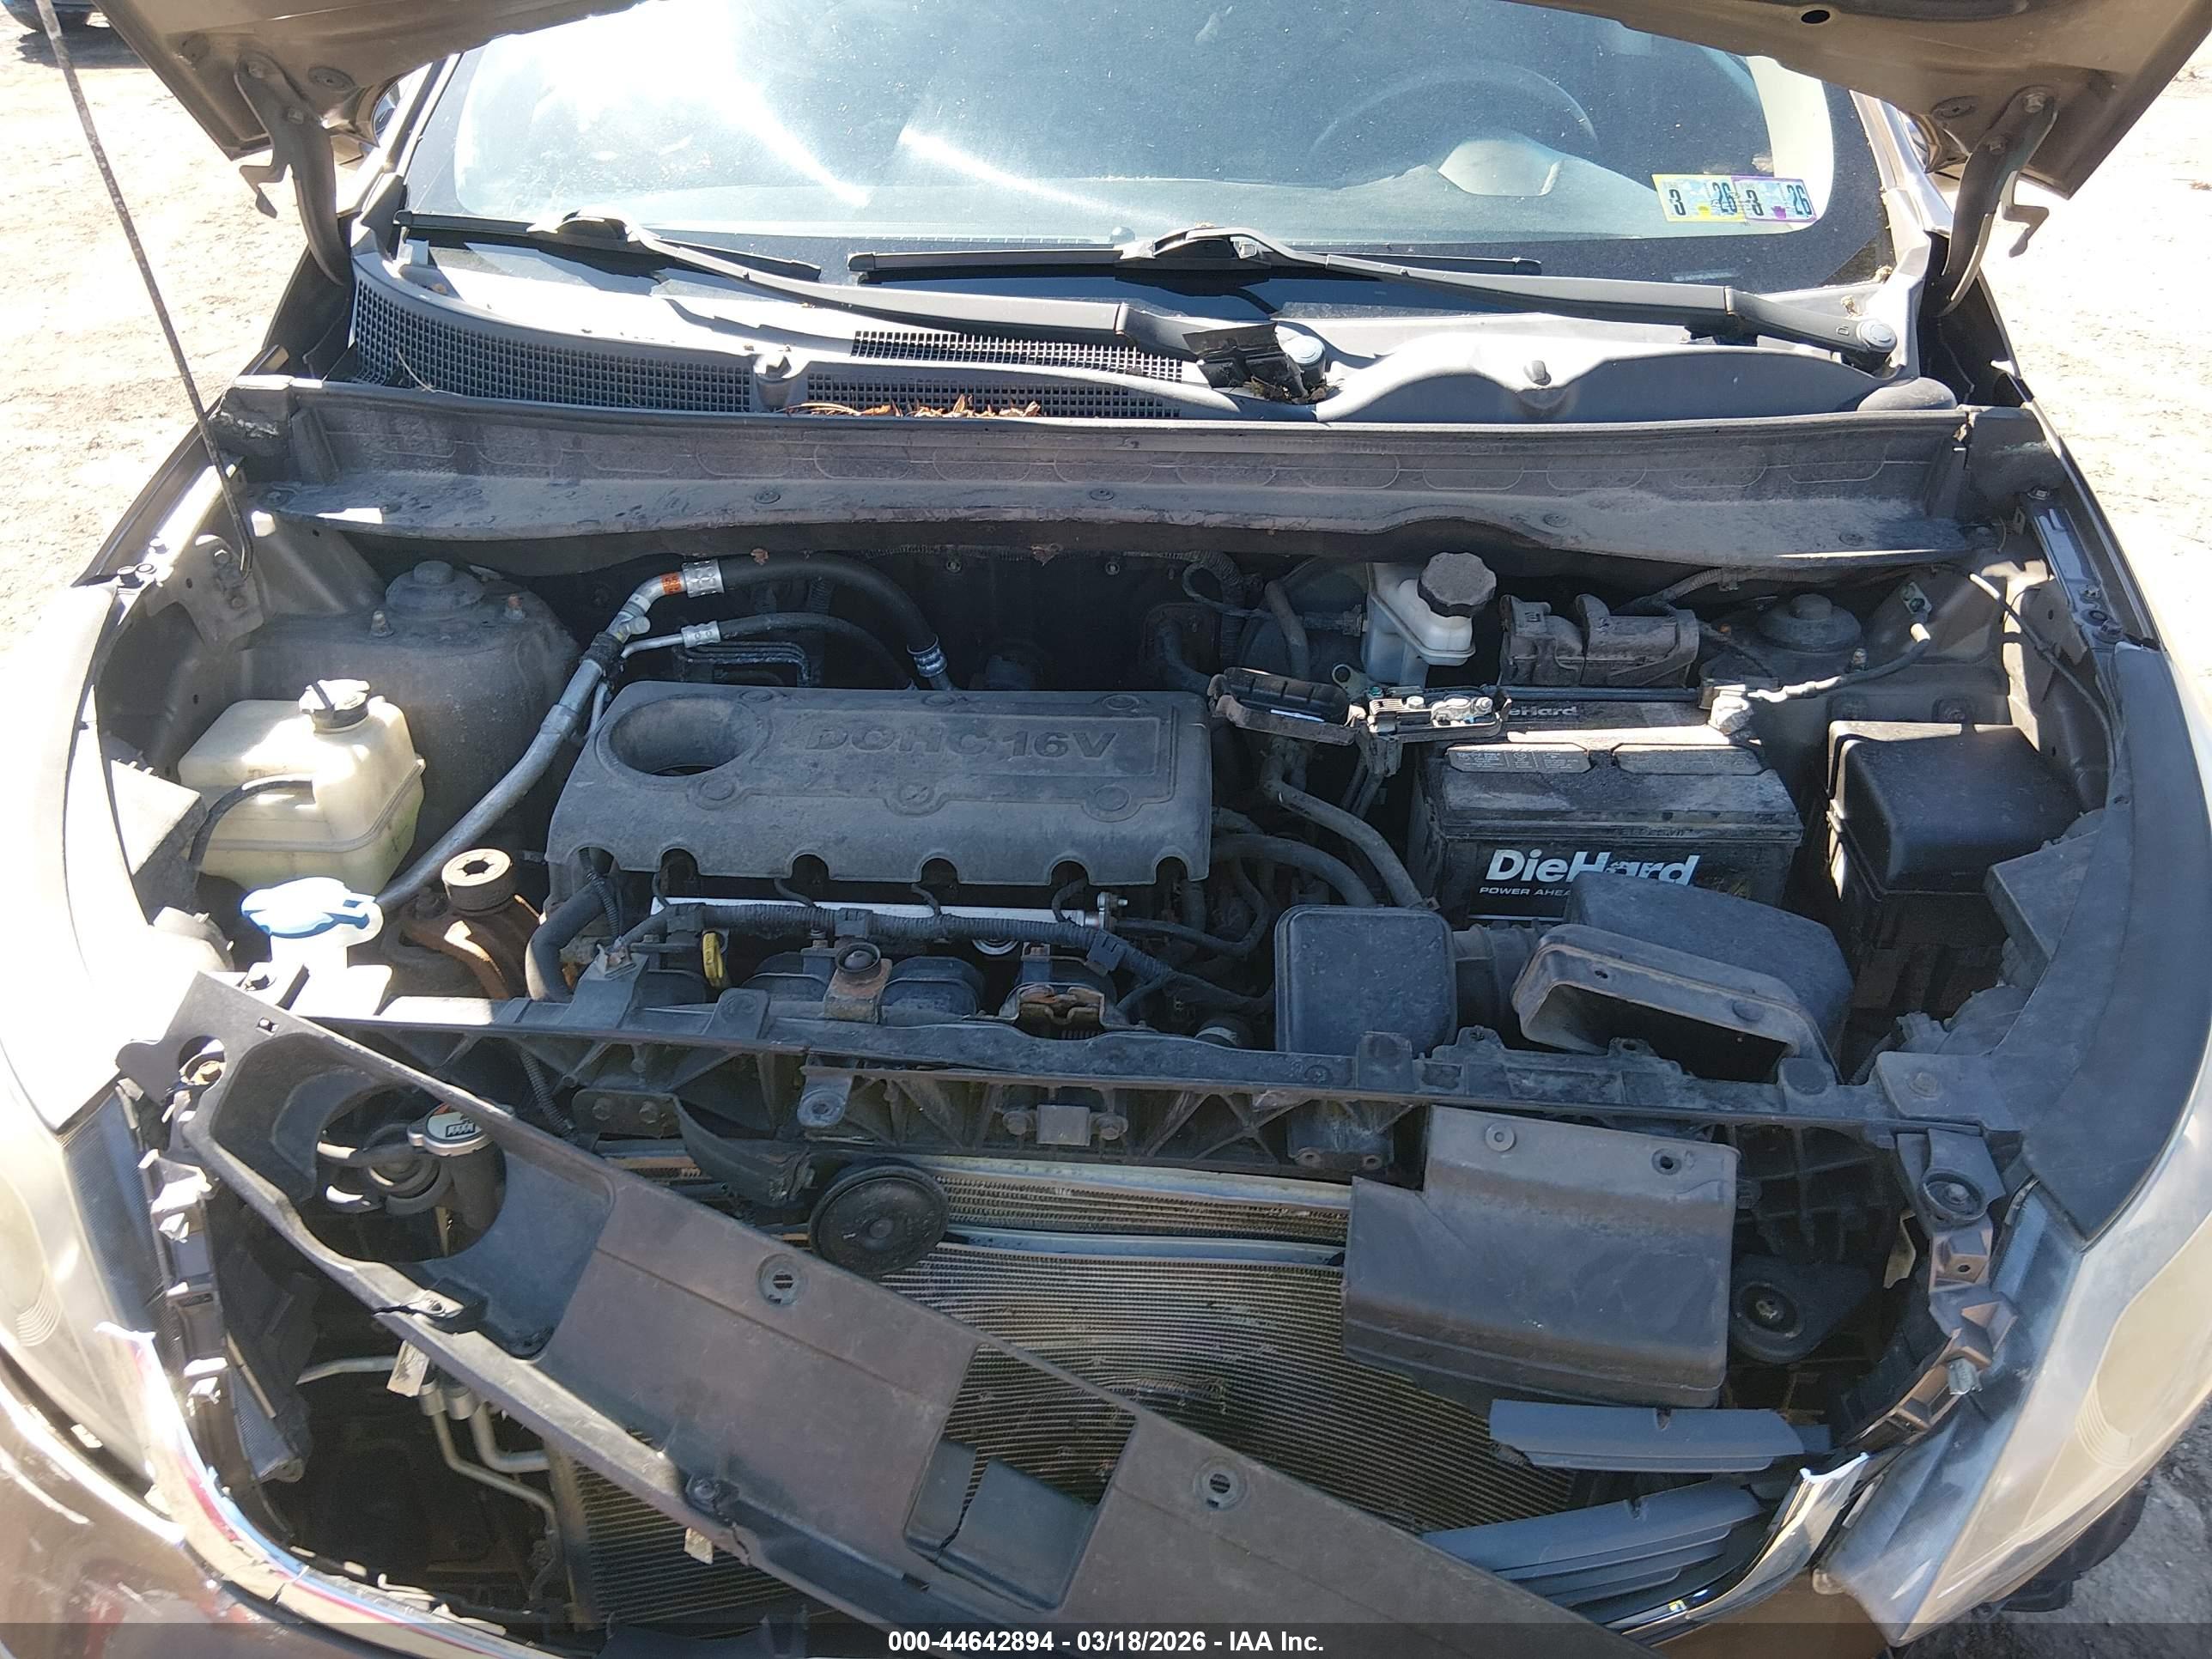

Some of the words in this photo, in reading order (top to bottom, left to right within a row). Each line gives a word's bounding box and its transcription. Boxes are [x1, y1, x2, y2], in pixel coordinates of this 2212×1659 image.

[1668, 189, 1686, 216] 3
[1712, 182, 1738, 214] 26
[1746, 189, 1765, 216] 3
[1786, 184, 1813, 216] 26
[1509, 706, 1577, 715] eHard
[805, 724, 988, 756] DOHC
[1002, 731, 1117, 758] 16V
[1485, 848, 1700, 886] DieHard
[1479, 886, 1530, 896] POWER
[1534, 888, 1571, 896] AHEA
